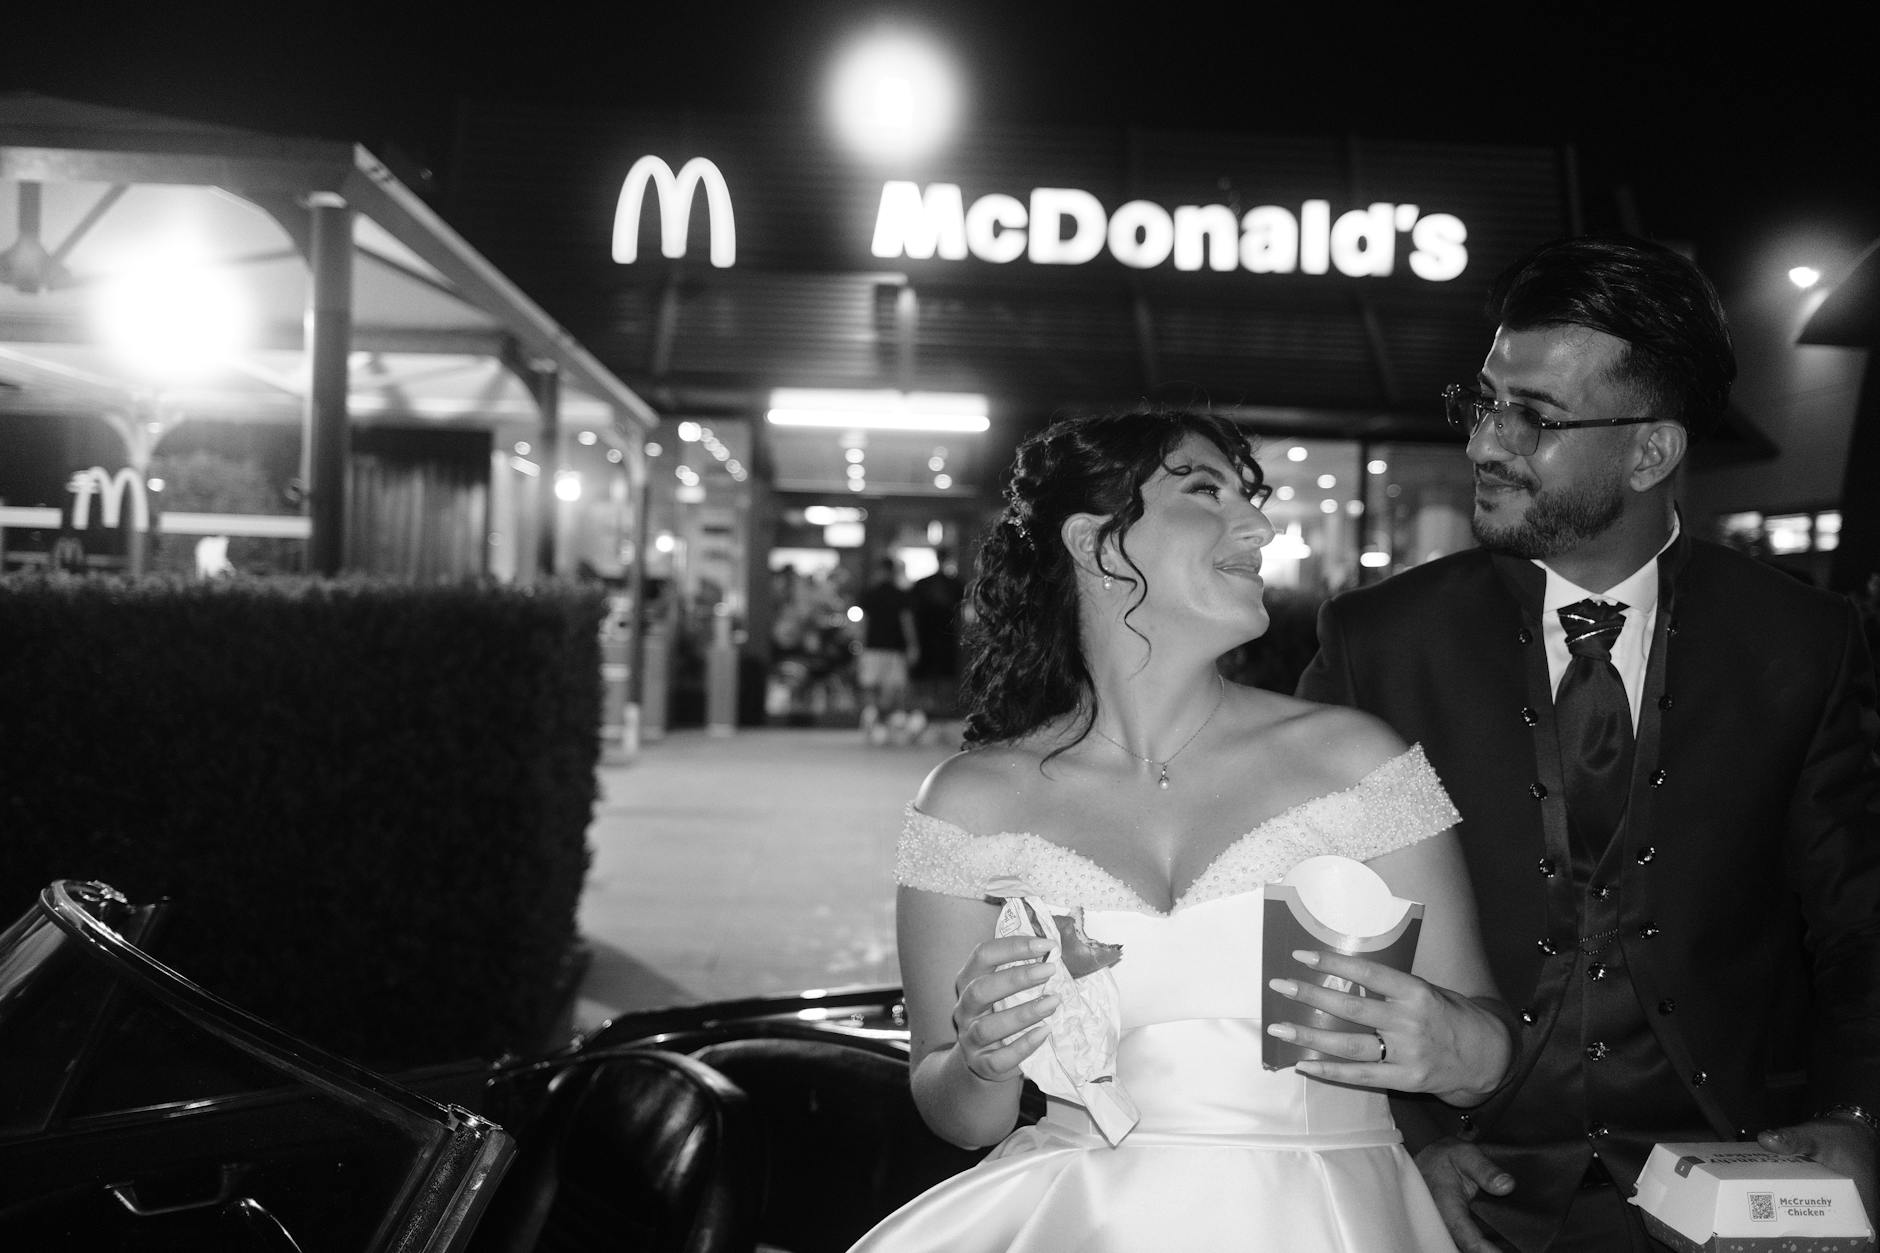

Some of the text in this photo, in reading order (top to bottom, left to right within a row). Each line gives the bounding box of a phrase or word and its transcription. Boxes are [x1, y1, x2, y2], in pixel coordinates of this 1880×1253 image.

[872, 180, 1469, 281] McDonald's
[1780, 1197, 1832, 1207] McCrunchy
[1787, 1208, 1825, 1216] Chicken
